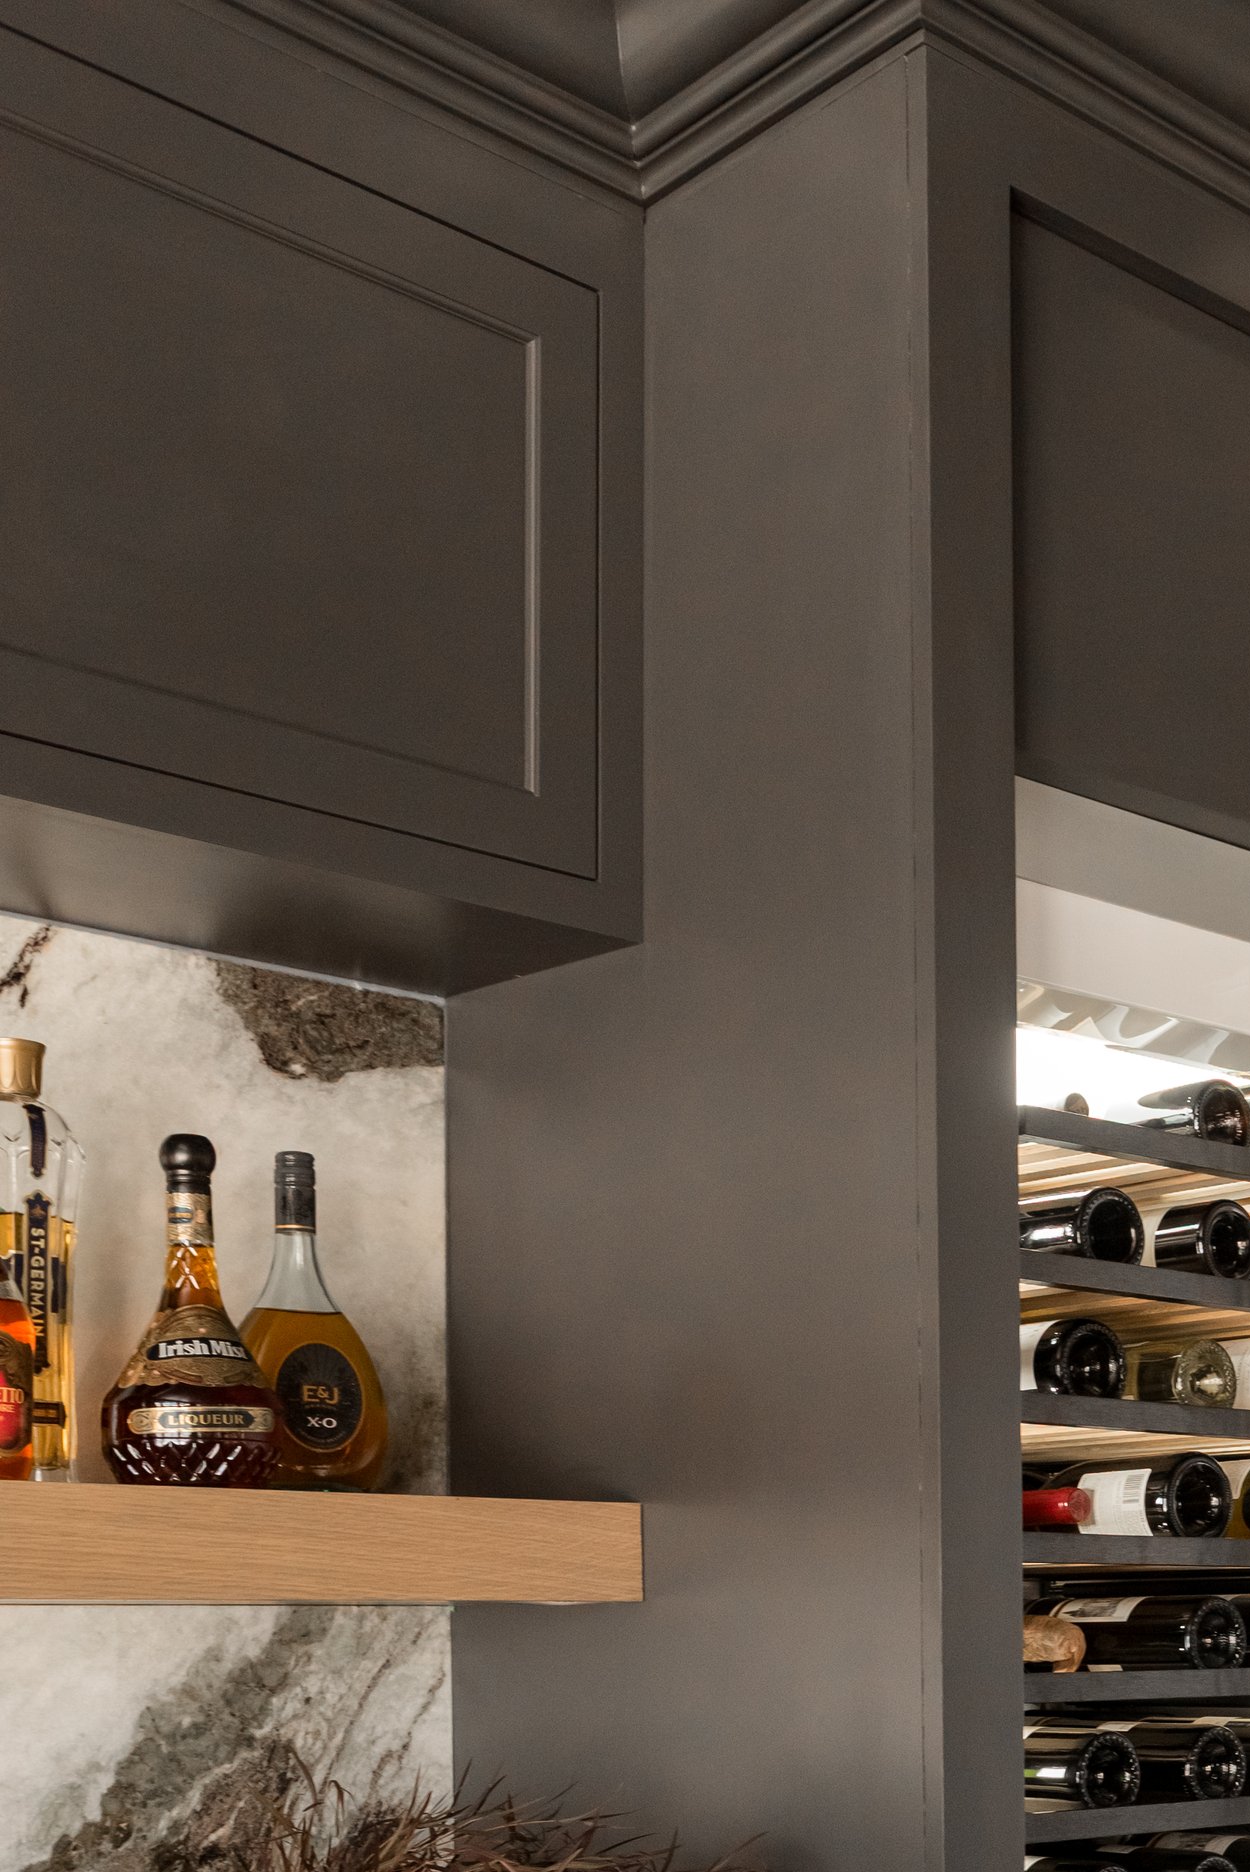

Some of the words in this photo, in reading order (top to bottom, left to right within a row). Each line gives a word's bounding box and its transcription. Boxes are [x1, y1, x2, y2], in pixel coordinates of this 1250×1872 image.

[30, 1227, 45, 1337] ST-GERMAIN
[158, 1340, 209, 1358] Irish
[303, 1385, 338, 1405] E&J
[168, 1414, 244, 1426] LIQUEUR
